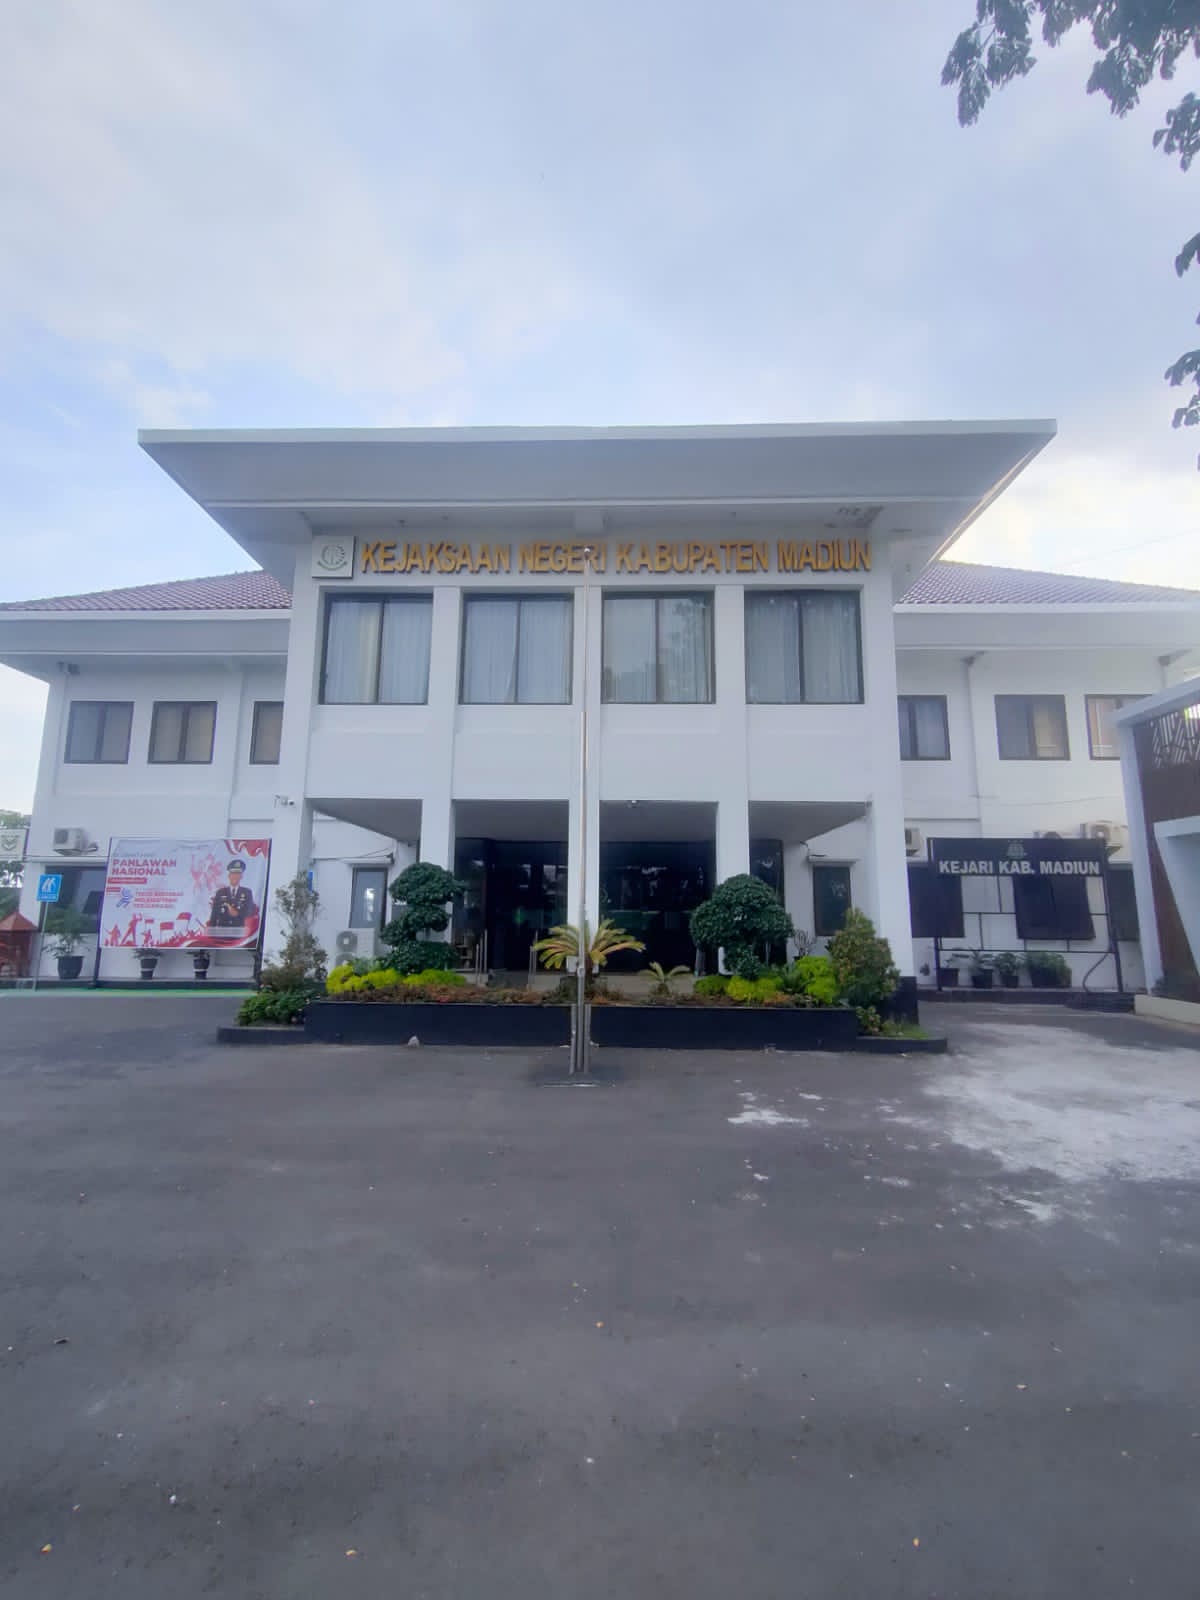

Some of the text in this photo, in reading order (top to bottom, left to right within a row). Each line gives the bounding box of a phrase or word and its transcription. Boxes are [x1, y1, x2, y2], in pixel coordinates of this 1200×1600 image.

[361, 539, 872, 573] KEJAKSAAN NEGERI KABUPATEN MADIUN
[111, 867, 168, 876] NASIONAL
[938, 860, 1100, 875] KEJARI KAB. MADIUN
